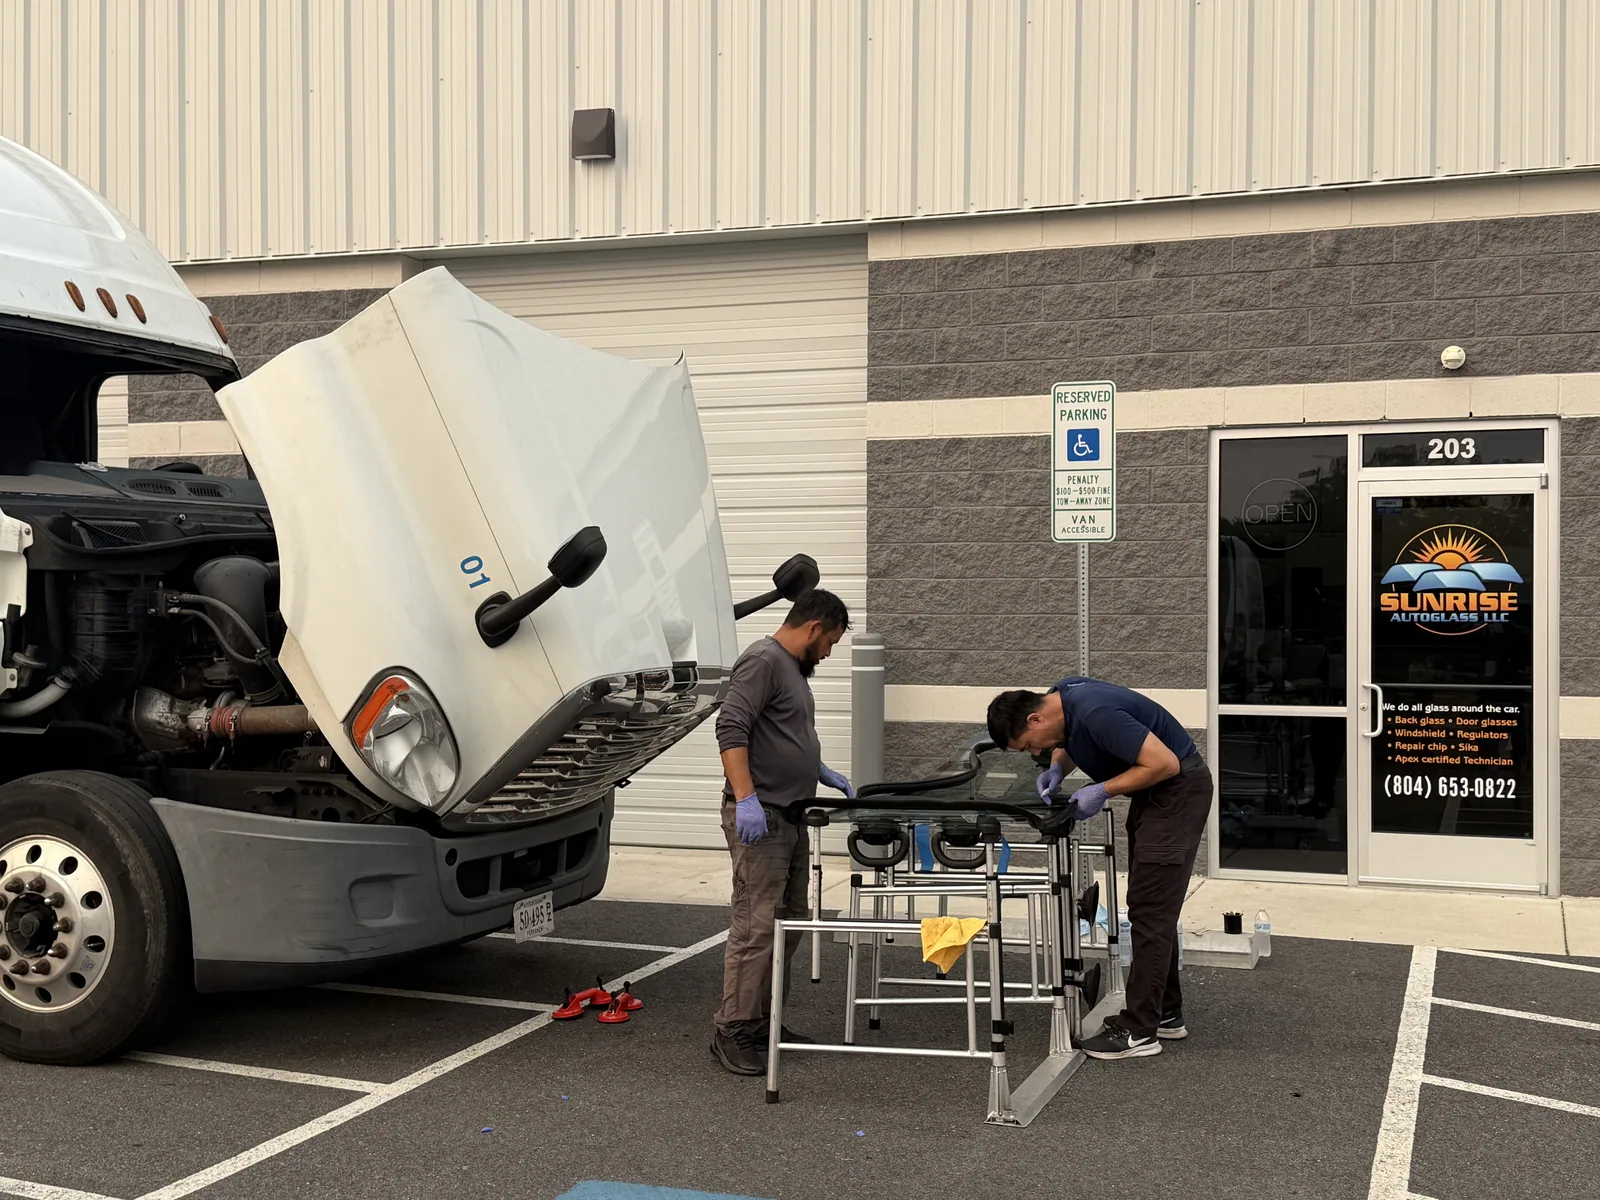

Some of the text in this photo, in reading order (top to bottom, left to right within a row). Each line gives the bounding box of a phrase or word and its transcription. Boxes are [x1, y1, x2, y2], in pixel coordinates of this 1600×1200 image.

[1056, 390, 1111, 404] RESERVED
[1060, 408, 1107, 421] PARKING
[1427, 437, 1476, 459] 203
[1067, 475, 1099, 485] PENALTY
[1096, 486, 1111, 495] FINE
[1094, 496, 1111, 505] ZONE
[1245, 502, 1312, 524] OPEN
[1071, 514, 1096, 525] VAN
[1061, 526, 1106, 534] ACCESSIBLE
[460, 555, 491, 589] 01
[1380, 592, 1518, 611] SUNRISE
[1390, 612, 1510, 622] AUTOGLASS LLC
[1382, 702, 1521, 714] We do all glass around the car.
[1394, 715, 1518, 728] Back glass Door glasses
[1394, 728, 1509, 741] Windshield Regulators
[1394, 741, 1479, 753] Repair chip Sika
[1394, 754, 1514, 766] Apex certified Technician
[1384, 774, 1516, 799] (804) 653-0822
